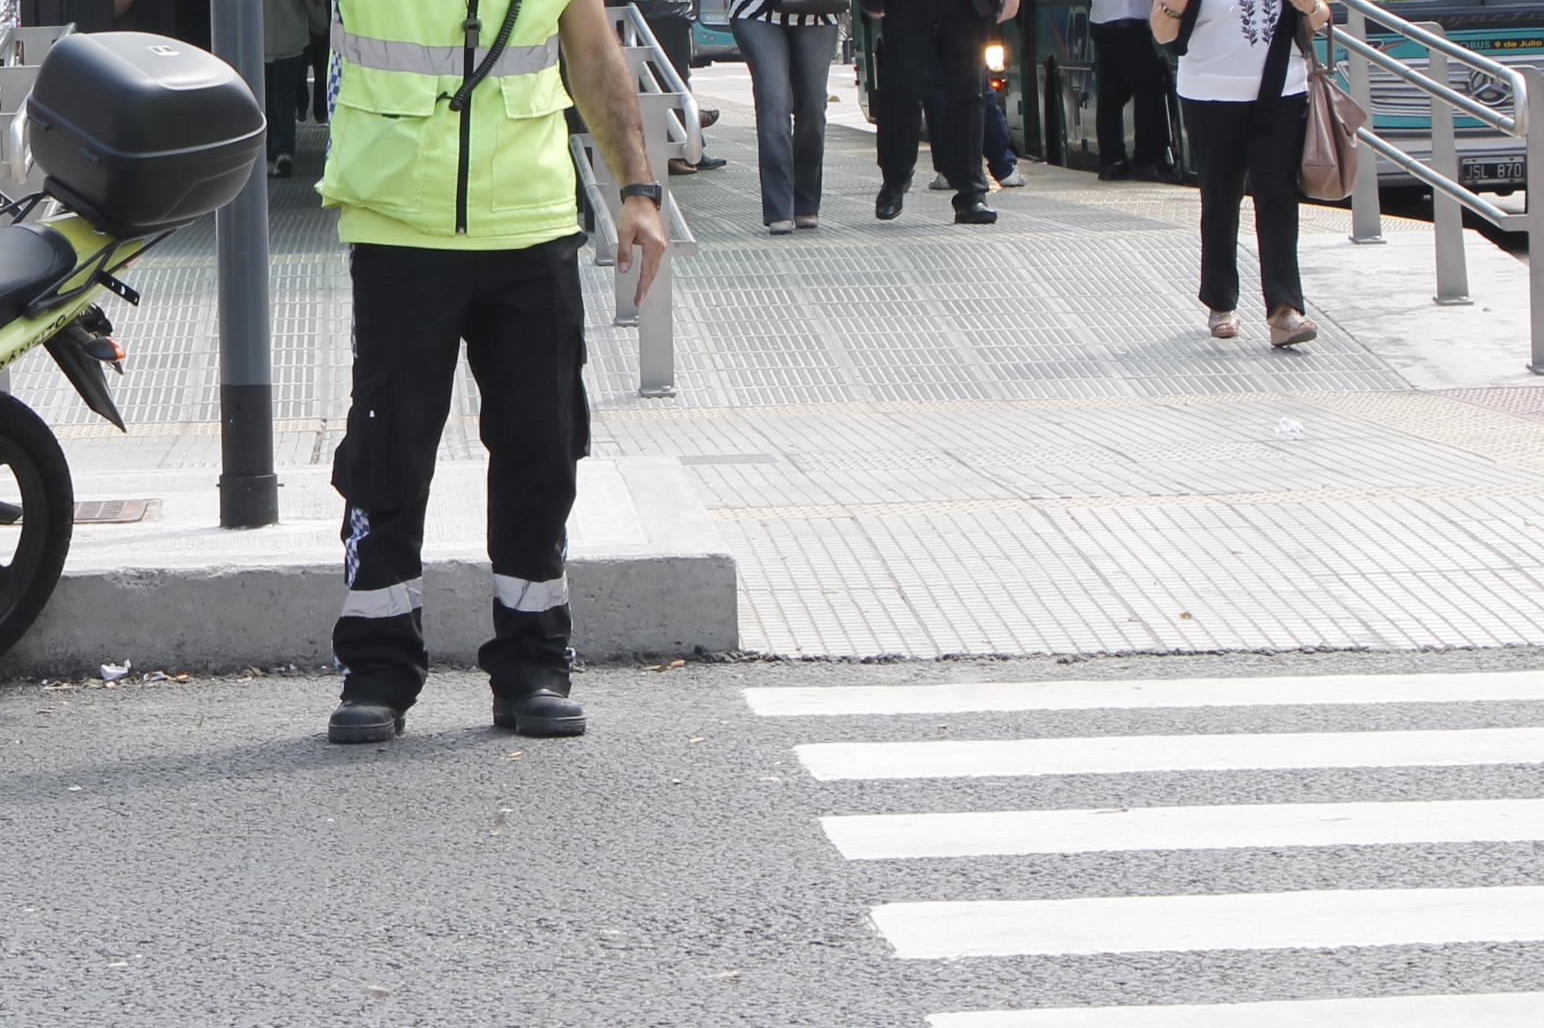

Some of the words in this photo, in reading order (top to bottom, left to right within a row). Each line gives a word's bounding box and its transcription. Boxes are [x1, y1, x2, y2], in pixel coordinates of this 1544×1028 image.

[1494, 40, 1501, 48] 9
[1503, 40, 1517, 48] de
[1519, 39, 1542, 48] Julio
[1465, 164, 1489, 179] JSL
[1497, 163, 1522, 178] 870
